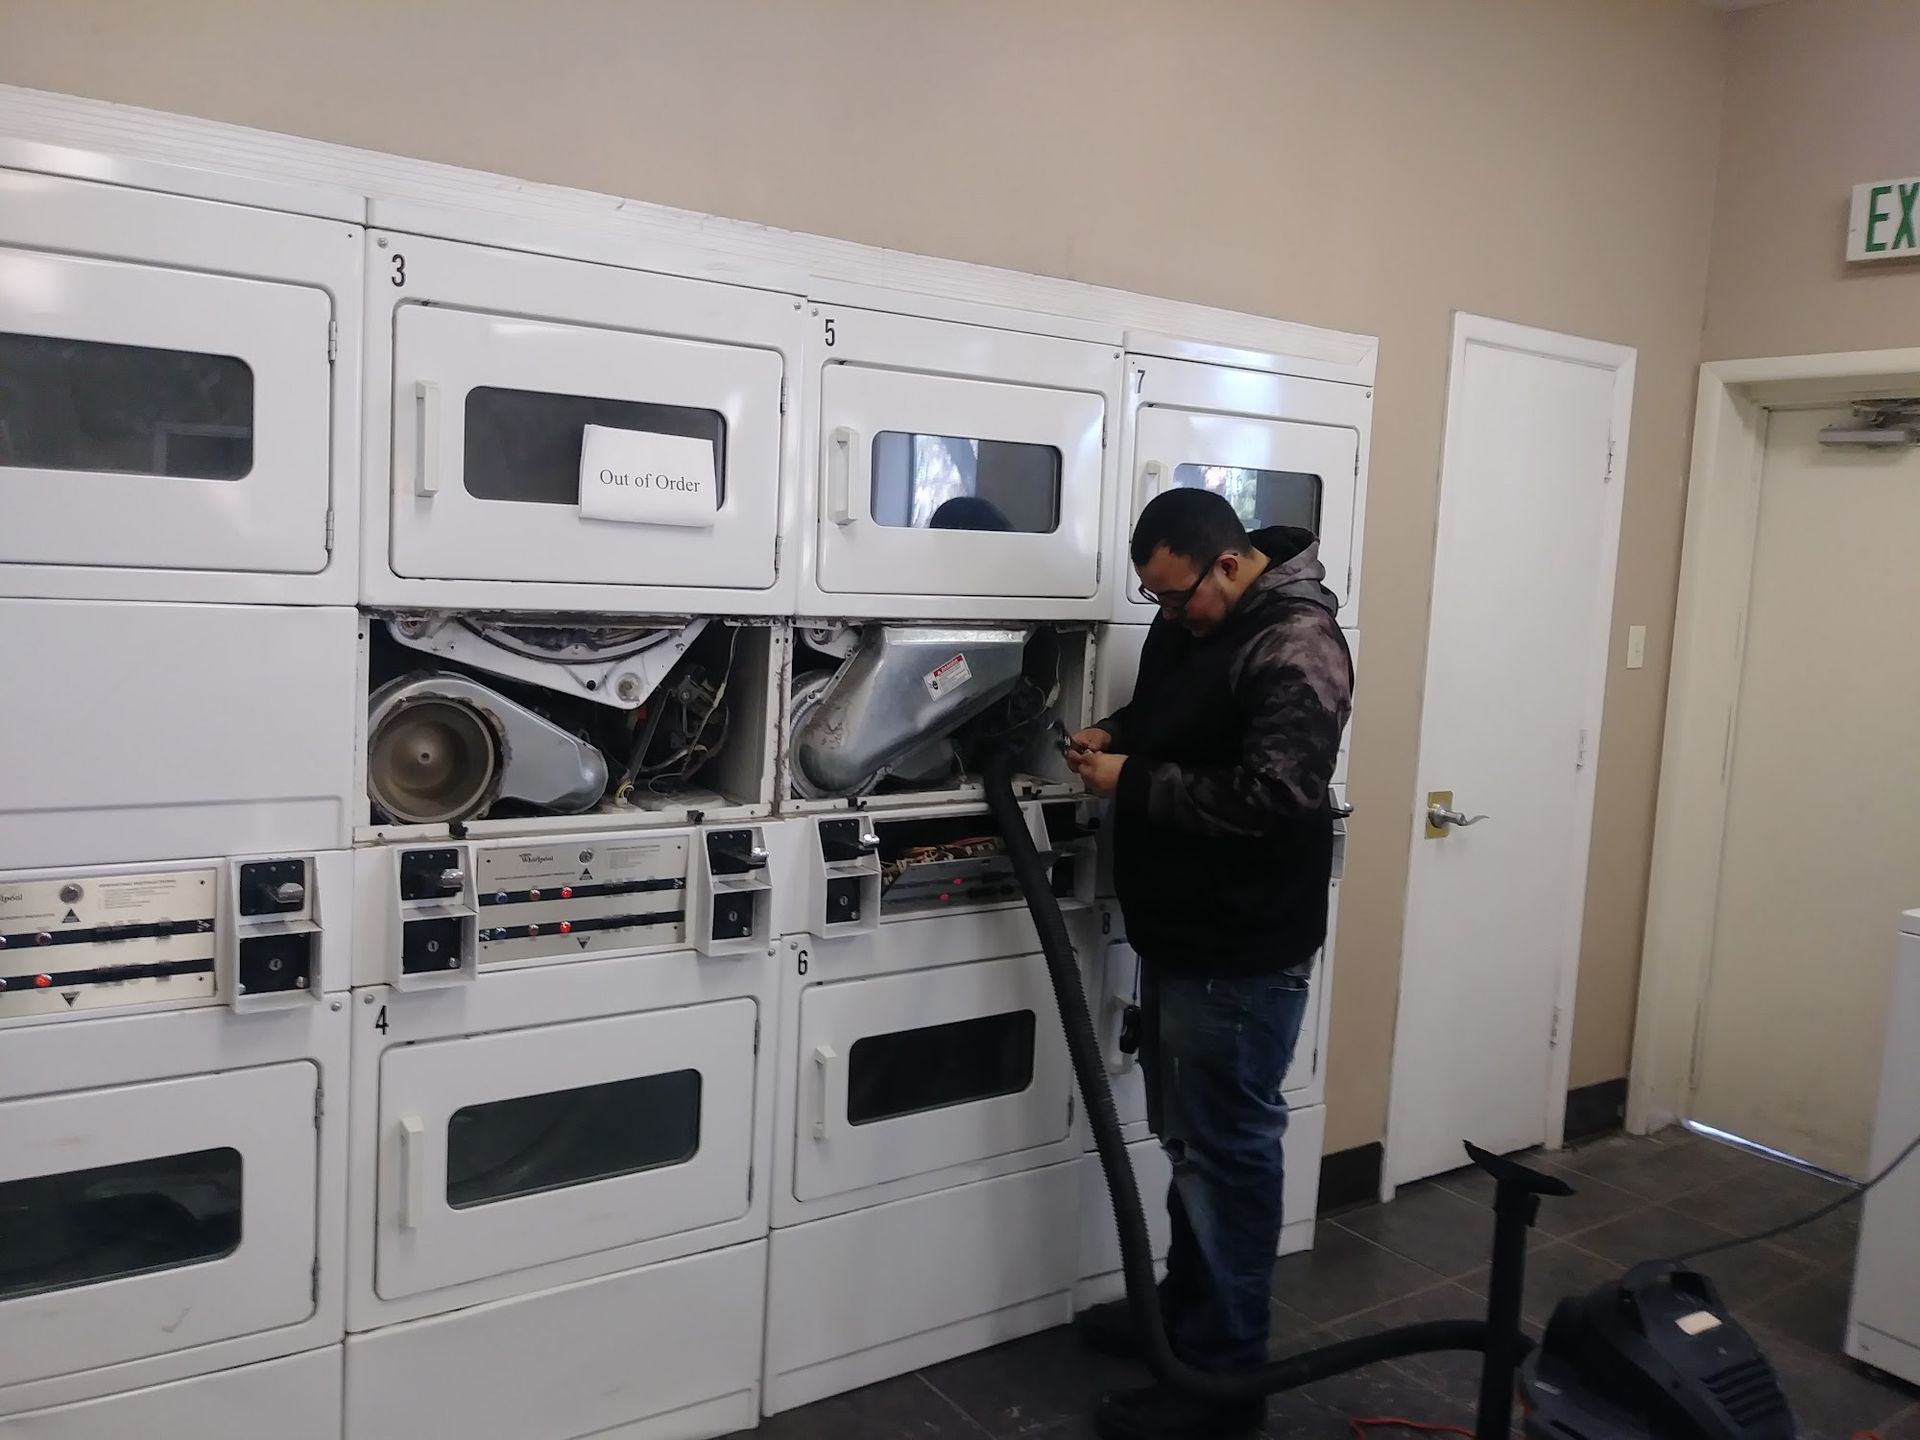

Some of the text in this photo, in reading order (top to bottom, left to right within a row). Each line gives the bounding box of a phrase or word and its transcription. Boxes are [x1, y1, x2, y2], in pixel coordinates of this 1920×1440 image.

[392, 254, 405, 287] 3
[825, 319, 835, 347] 5
[1137, 369, 1145, 394] 7
[599, 469, 700, 492] Out of Order
[798, 949, 808, 975] 6
[375, 1005, 389, 1035] 4
